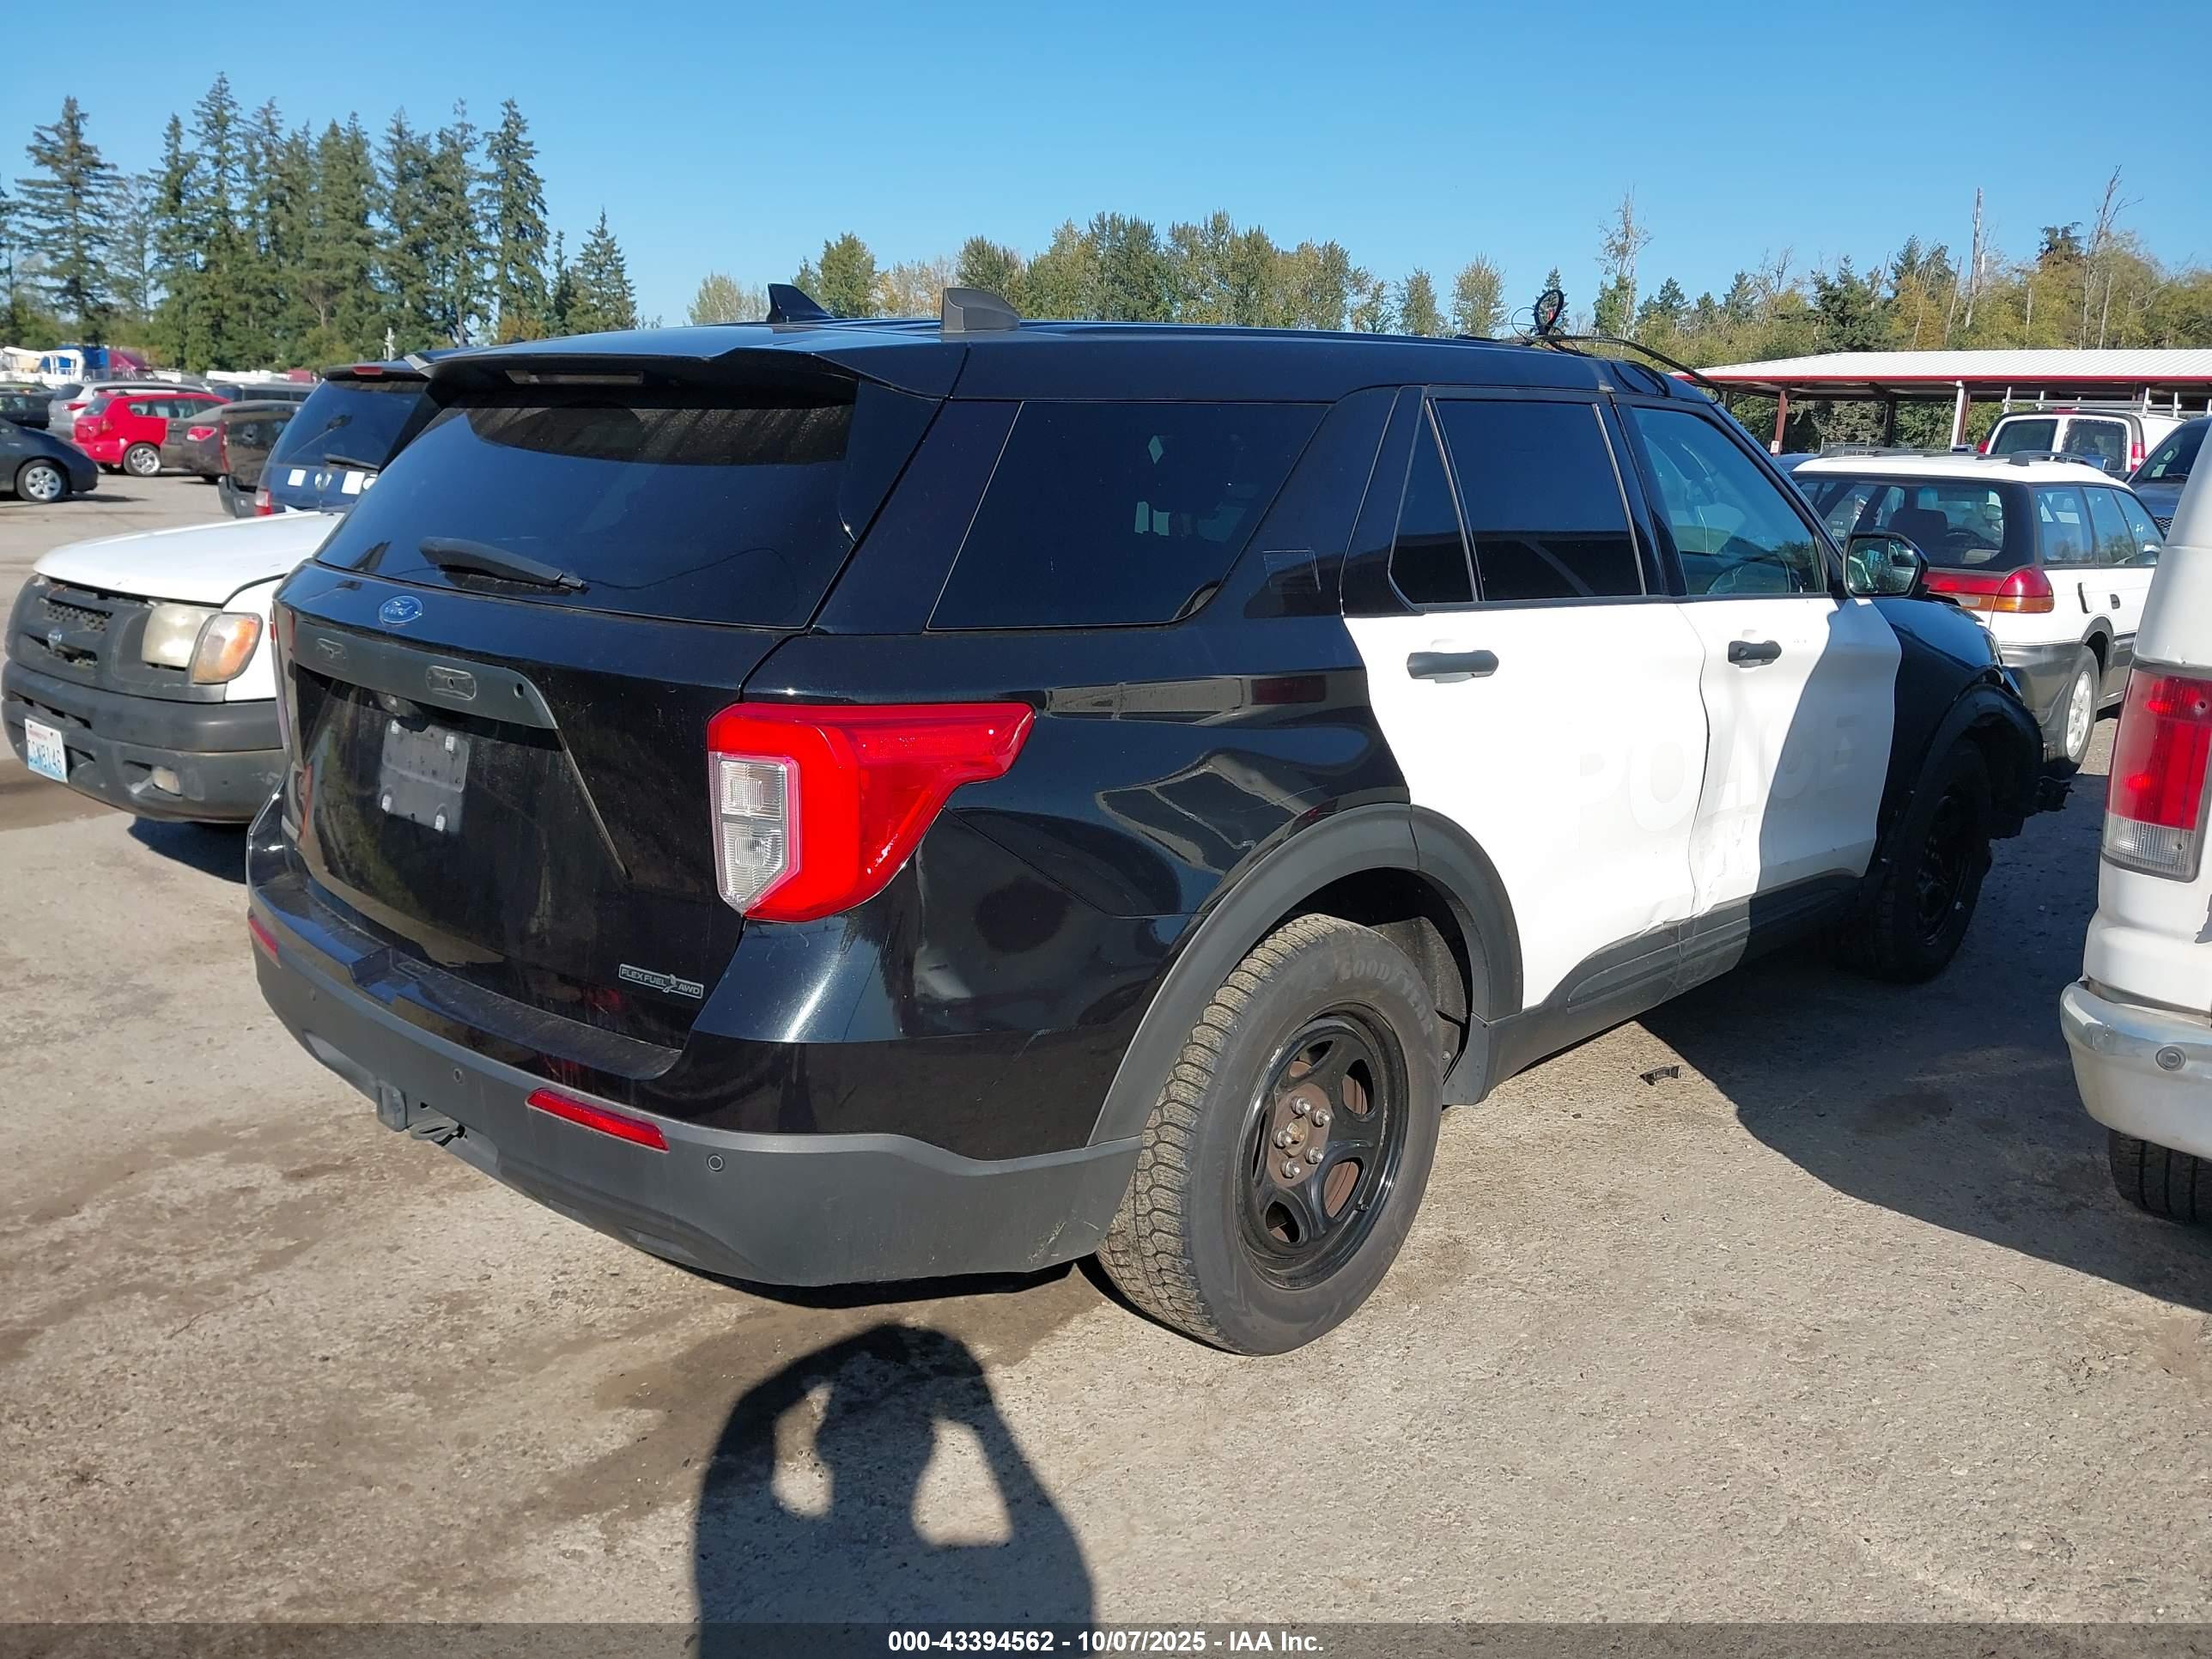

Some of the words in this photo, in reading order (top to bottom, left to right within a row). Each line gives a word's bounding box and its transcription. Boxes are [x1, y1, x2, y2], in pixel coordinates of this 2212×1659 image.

[620, 968, 644, 981] FLEX
[644, 975, 667, 987] FUEL
[678, 982, 701, 994] AWD
